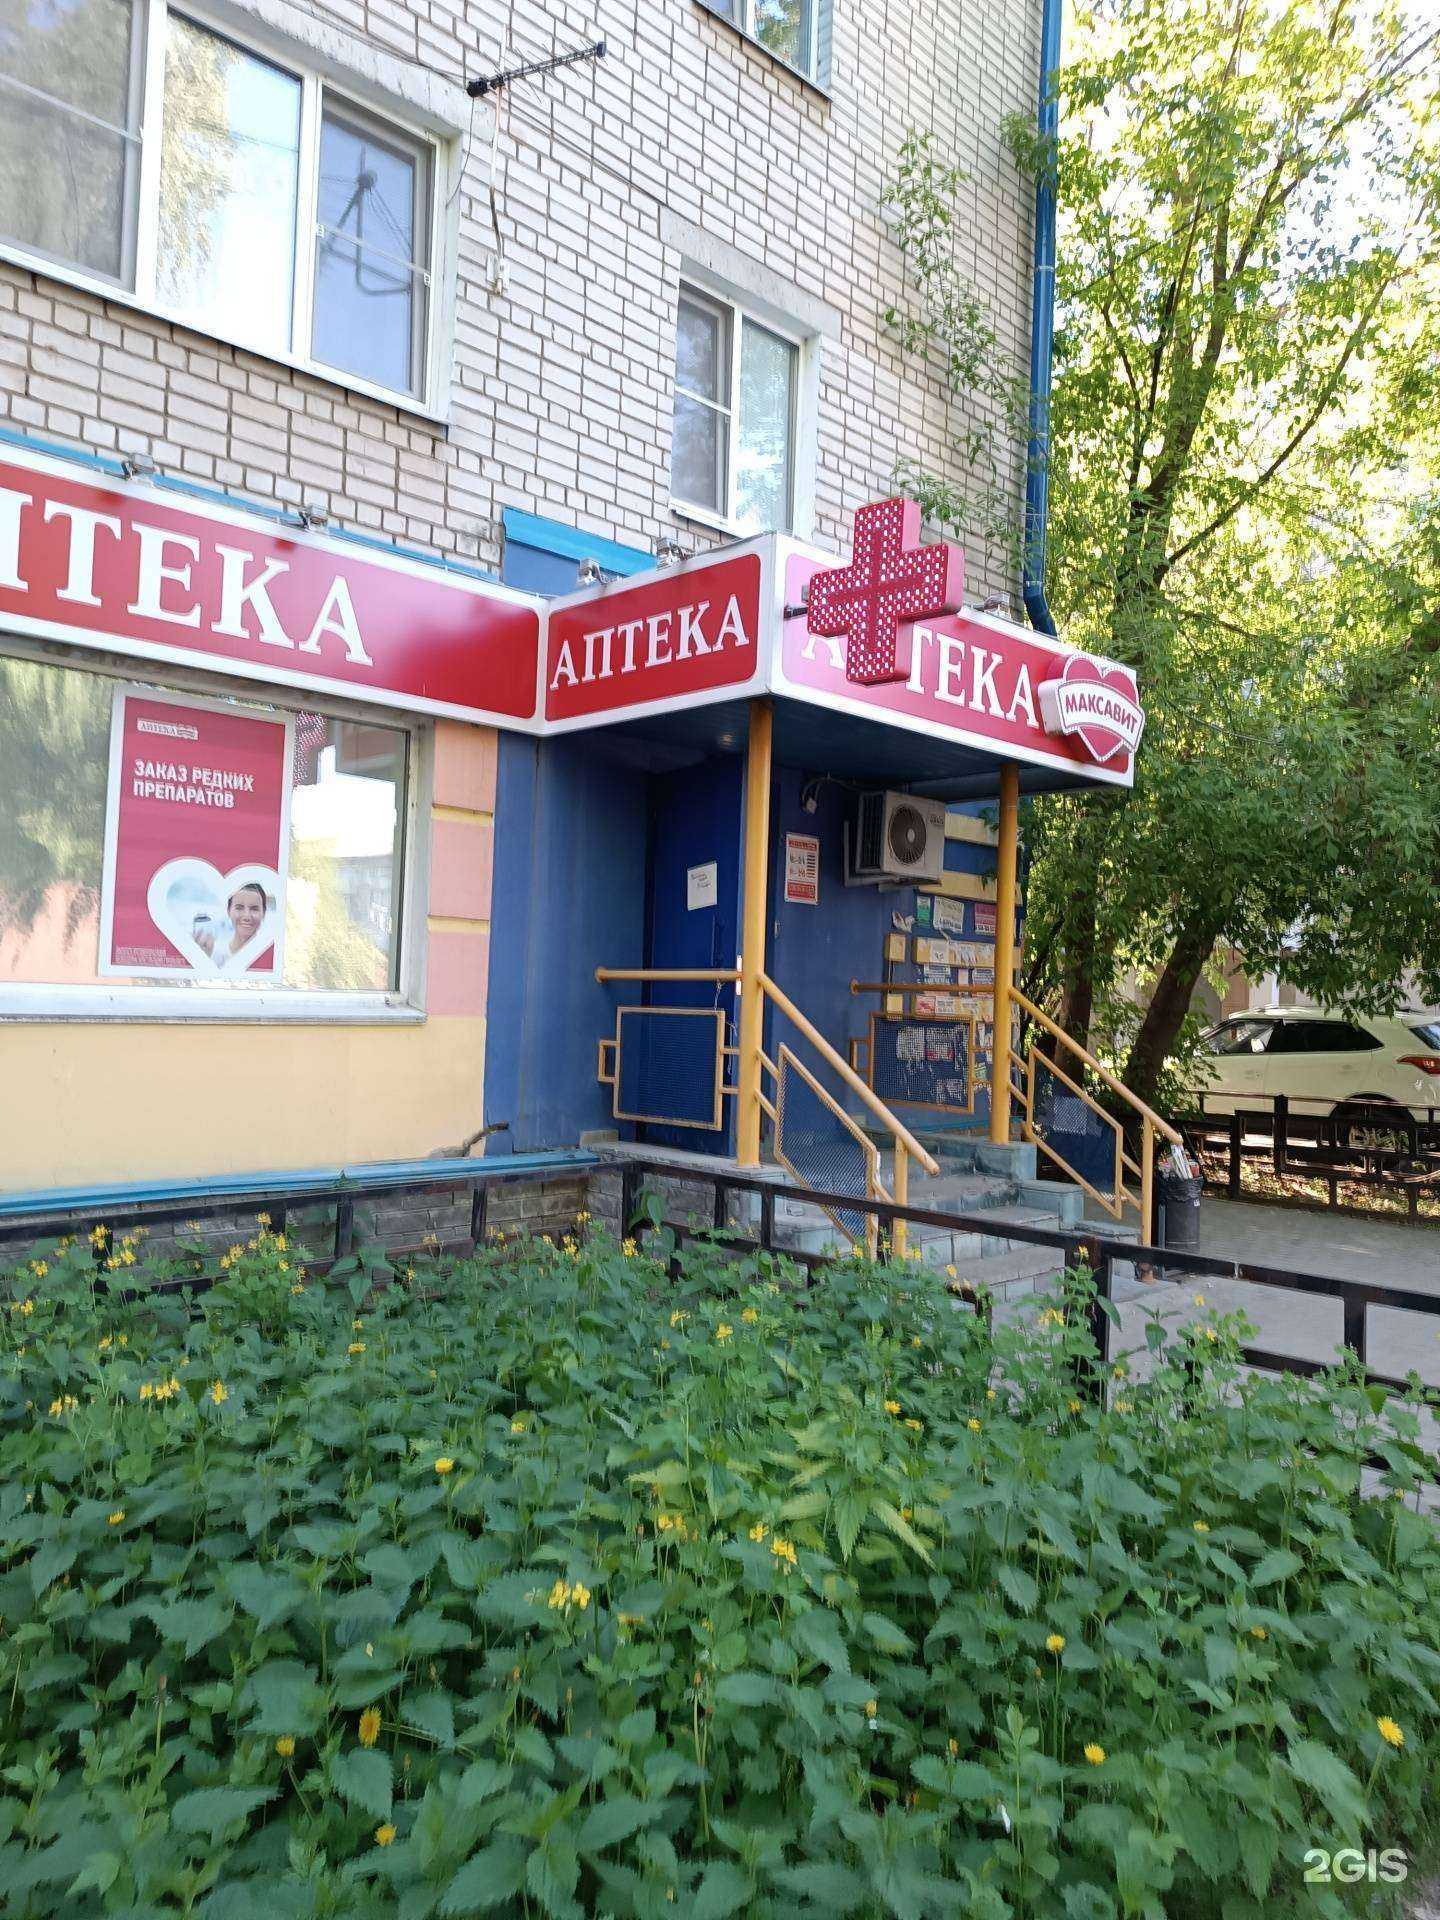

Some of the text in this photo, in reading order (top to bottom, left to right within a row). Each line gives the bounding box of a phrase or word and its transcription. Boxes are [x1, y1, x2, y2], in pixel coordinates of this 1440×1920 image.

[549, 594, 750, 692] АПТЕКА
[801, 624, 1040, 730] ТЕКА
[1064, 693, 1138, 734] МАКСАВИТ
[133, 778, 235, 809] ПРЕПАРАТОВ
[134, 758, 255, 793] ЗАКАЗ РЕДКИХ
